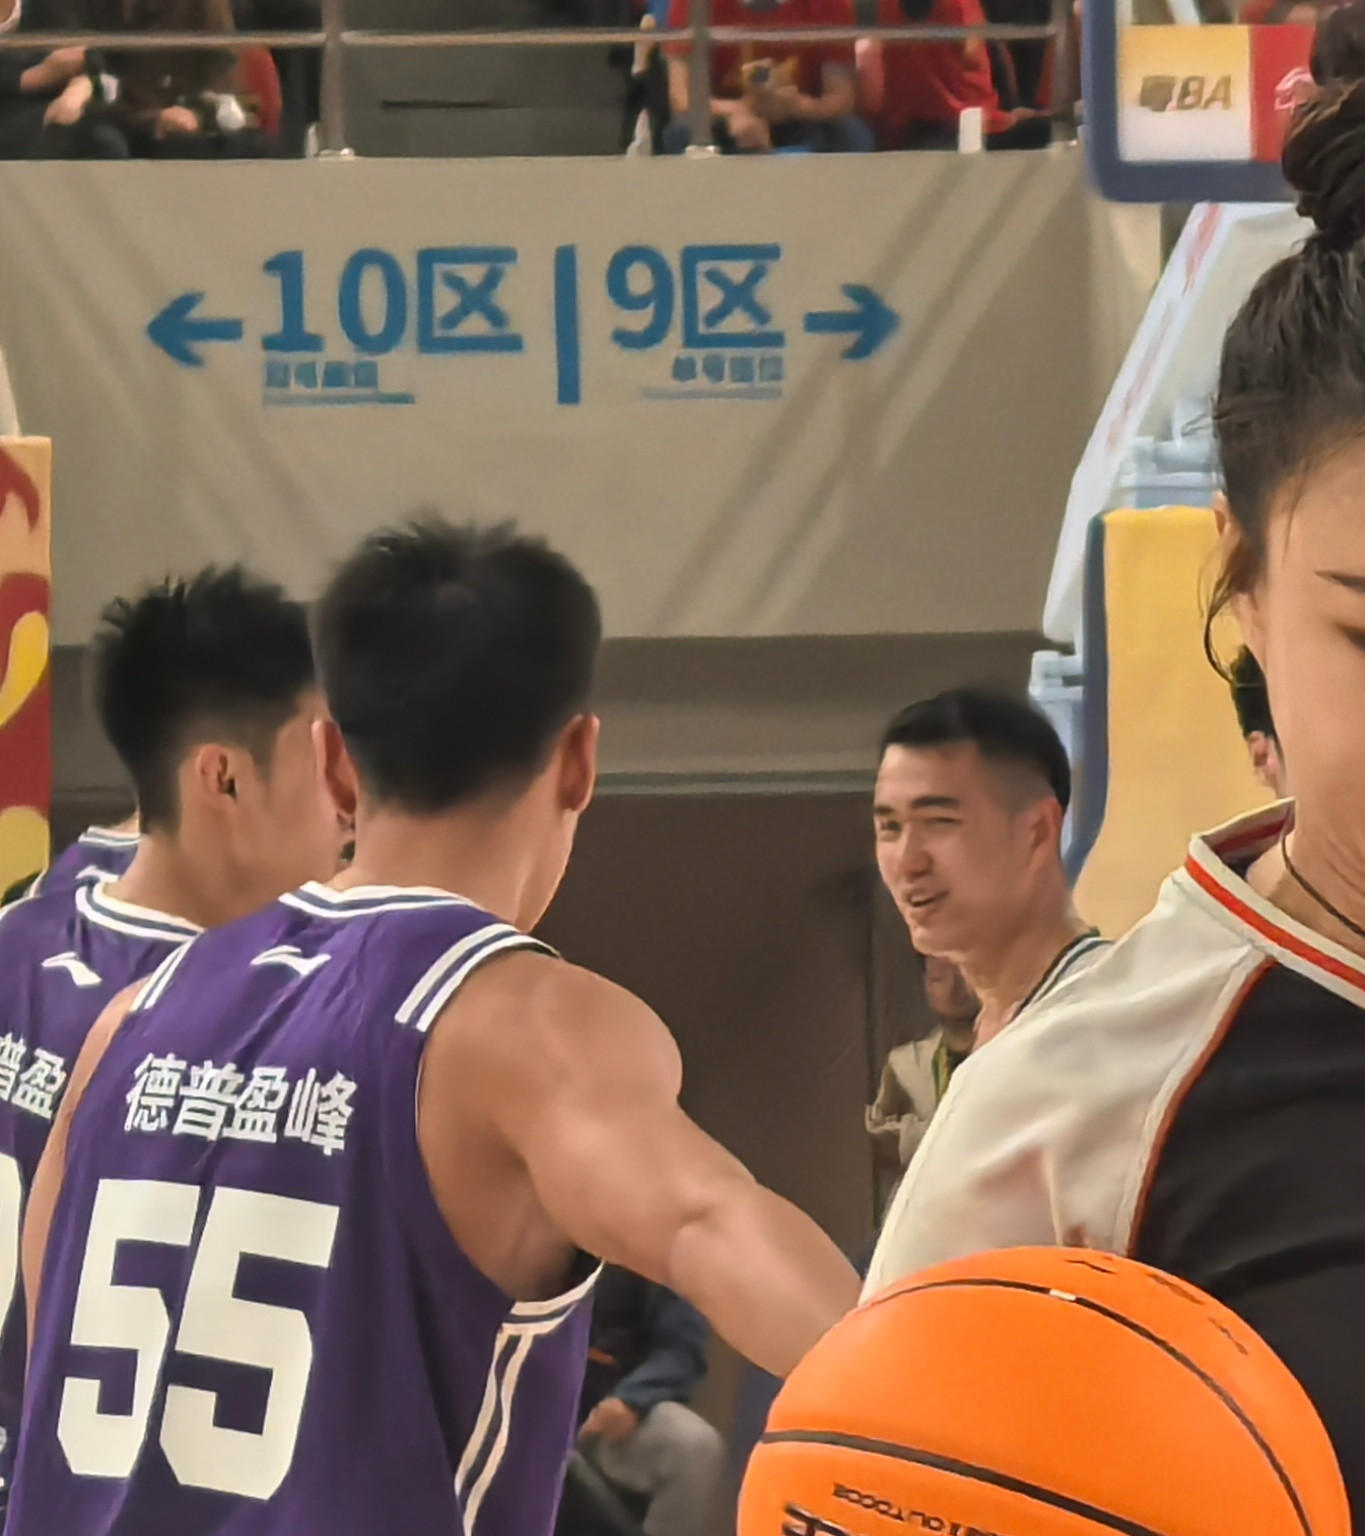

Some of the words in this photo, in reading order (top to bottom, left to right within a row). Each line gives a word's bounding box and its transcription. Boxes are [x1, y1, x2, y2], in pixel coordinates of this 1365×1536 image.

[261, 246, 523, 354] 10区
[605, 243, 785, 350] 9区
[125, 1053, 358, 1156] 德普盈峰
[56, 1178, 340, 1501] 55
